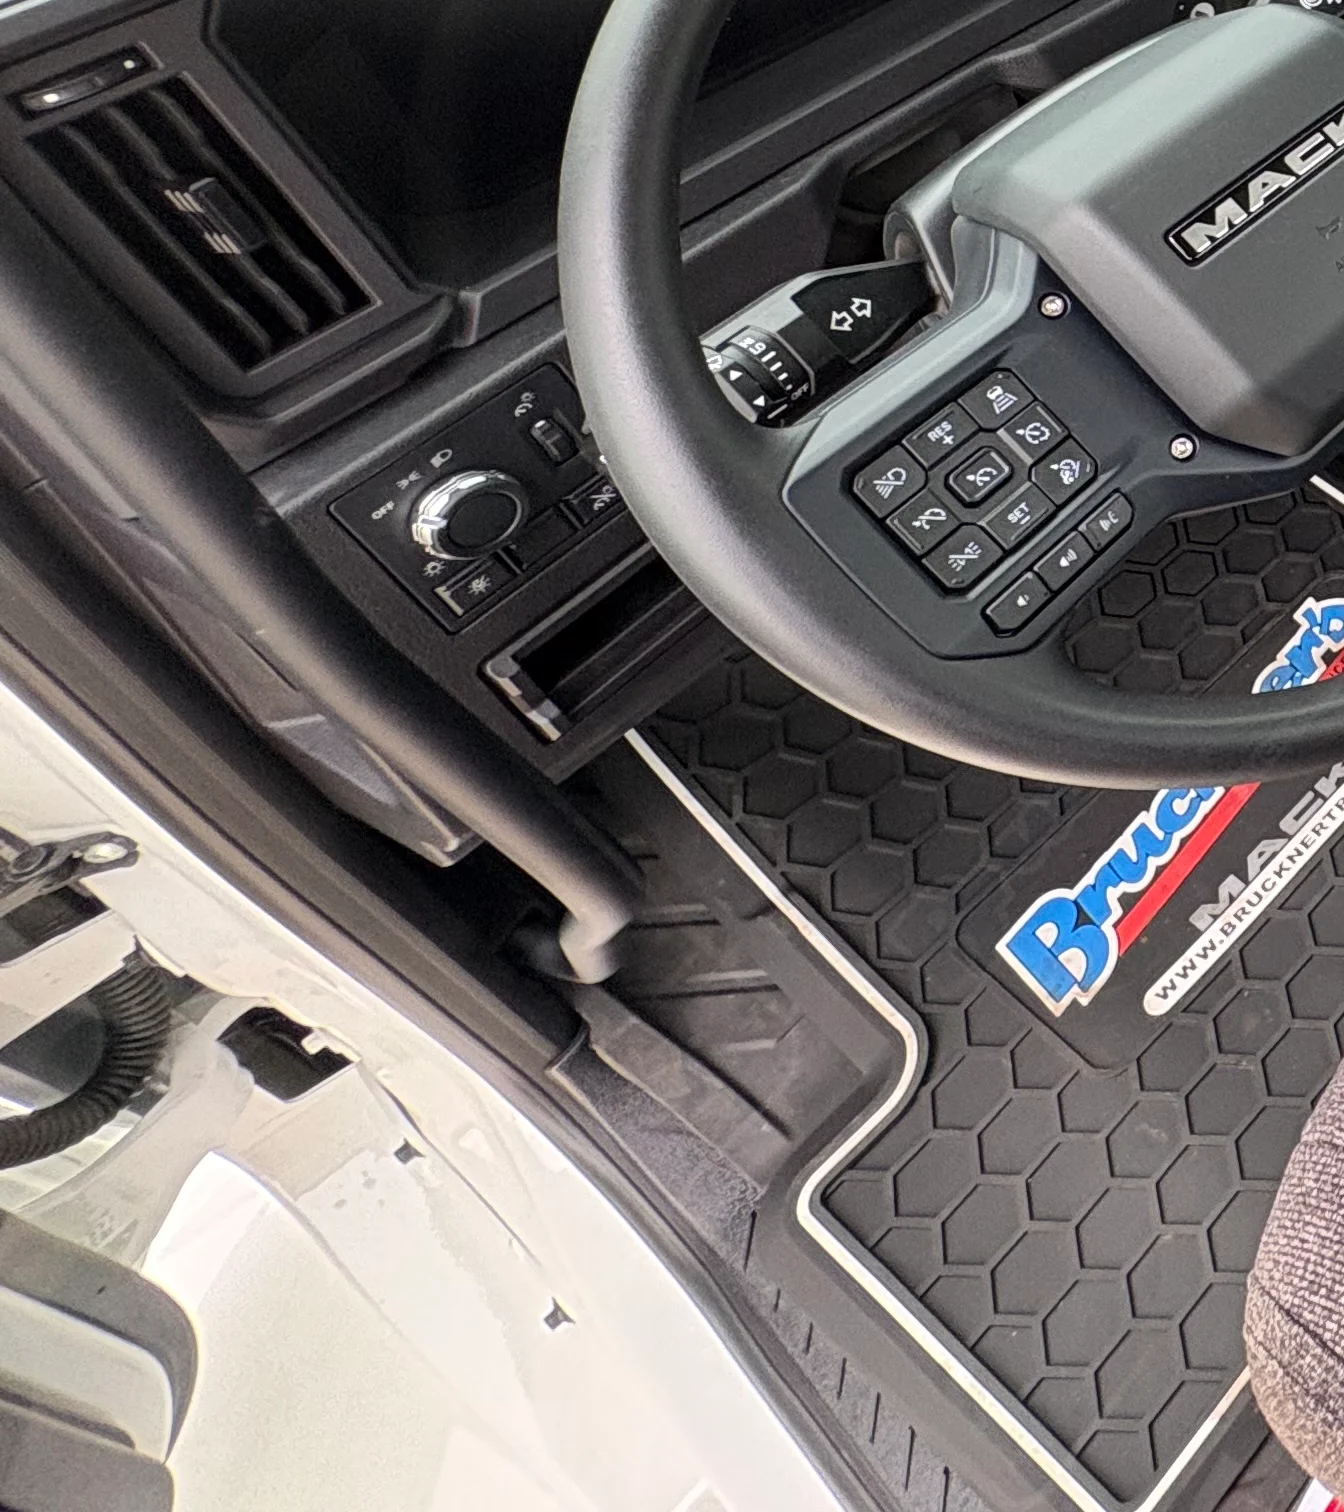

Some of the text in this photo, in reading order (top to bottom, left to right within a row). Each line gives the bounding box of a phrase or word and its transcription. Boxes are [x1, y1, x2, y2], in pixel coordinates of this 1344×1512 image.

[927, 420, 952, 442] RES
[371, 500, 395, 520] OFF
[1007, 502, 1030, 524] SET
